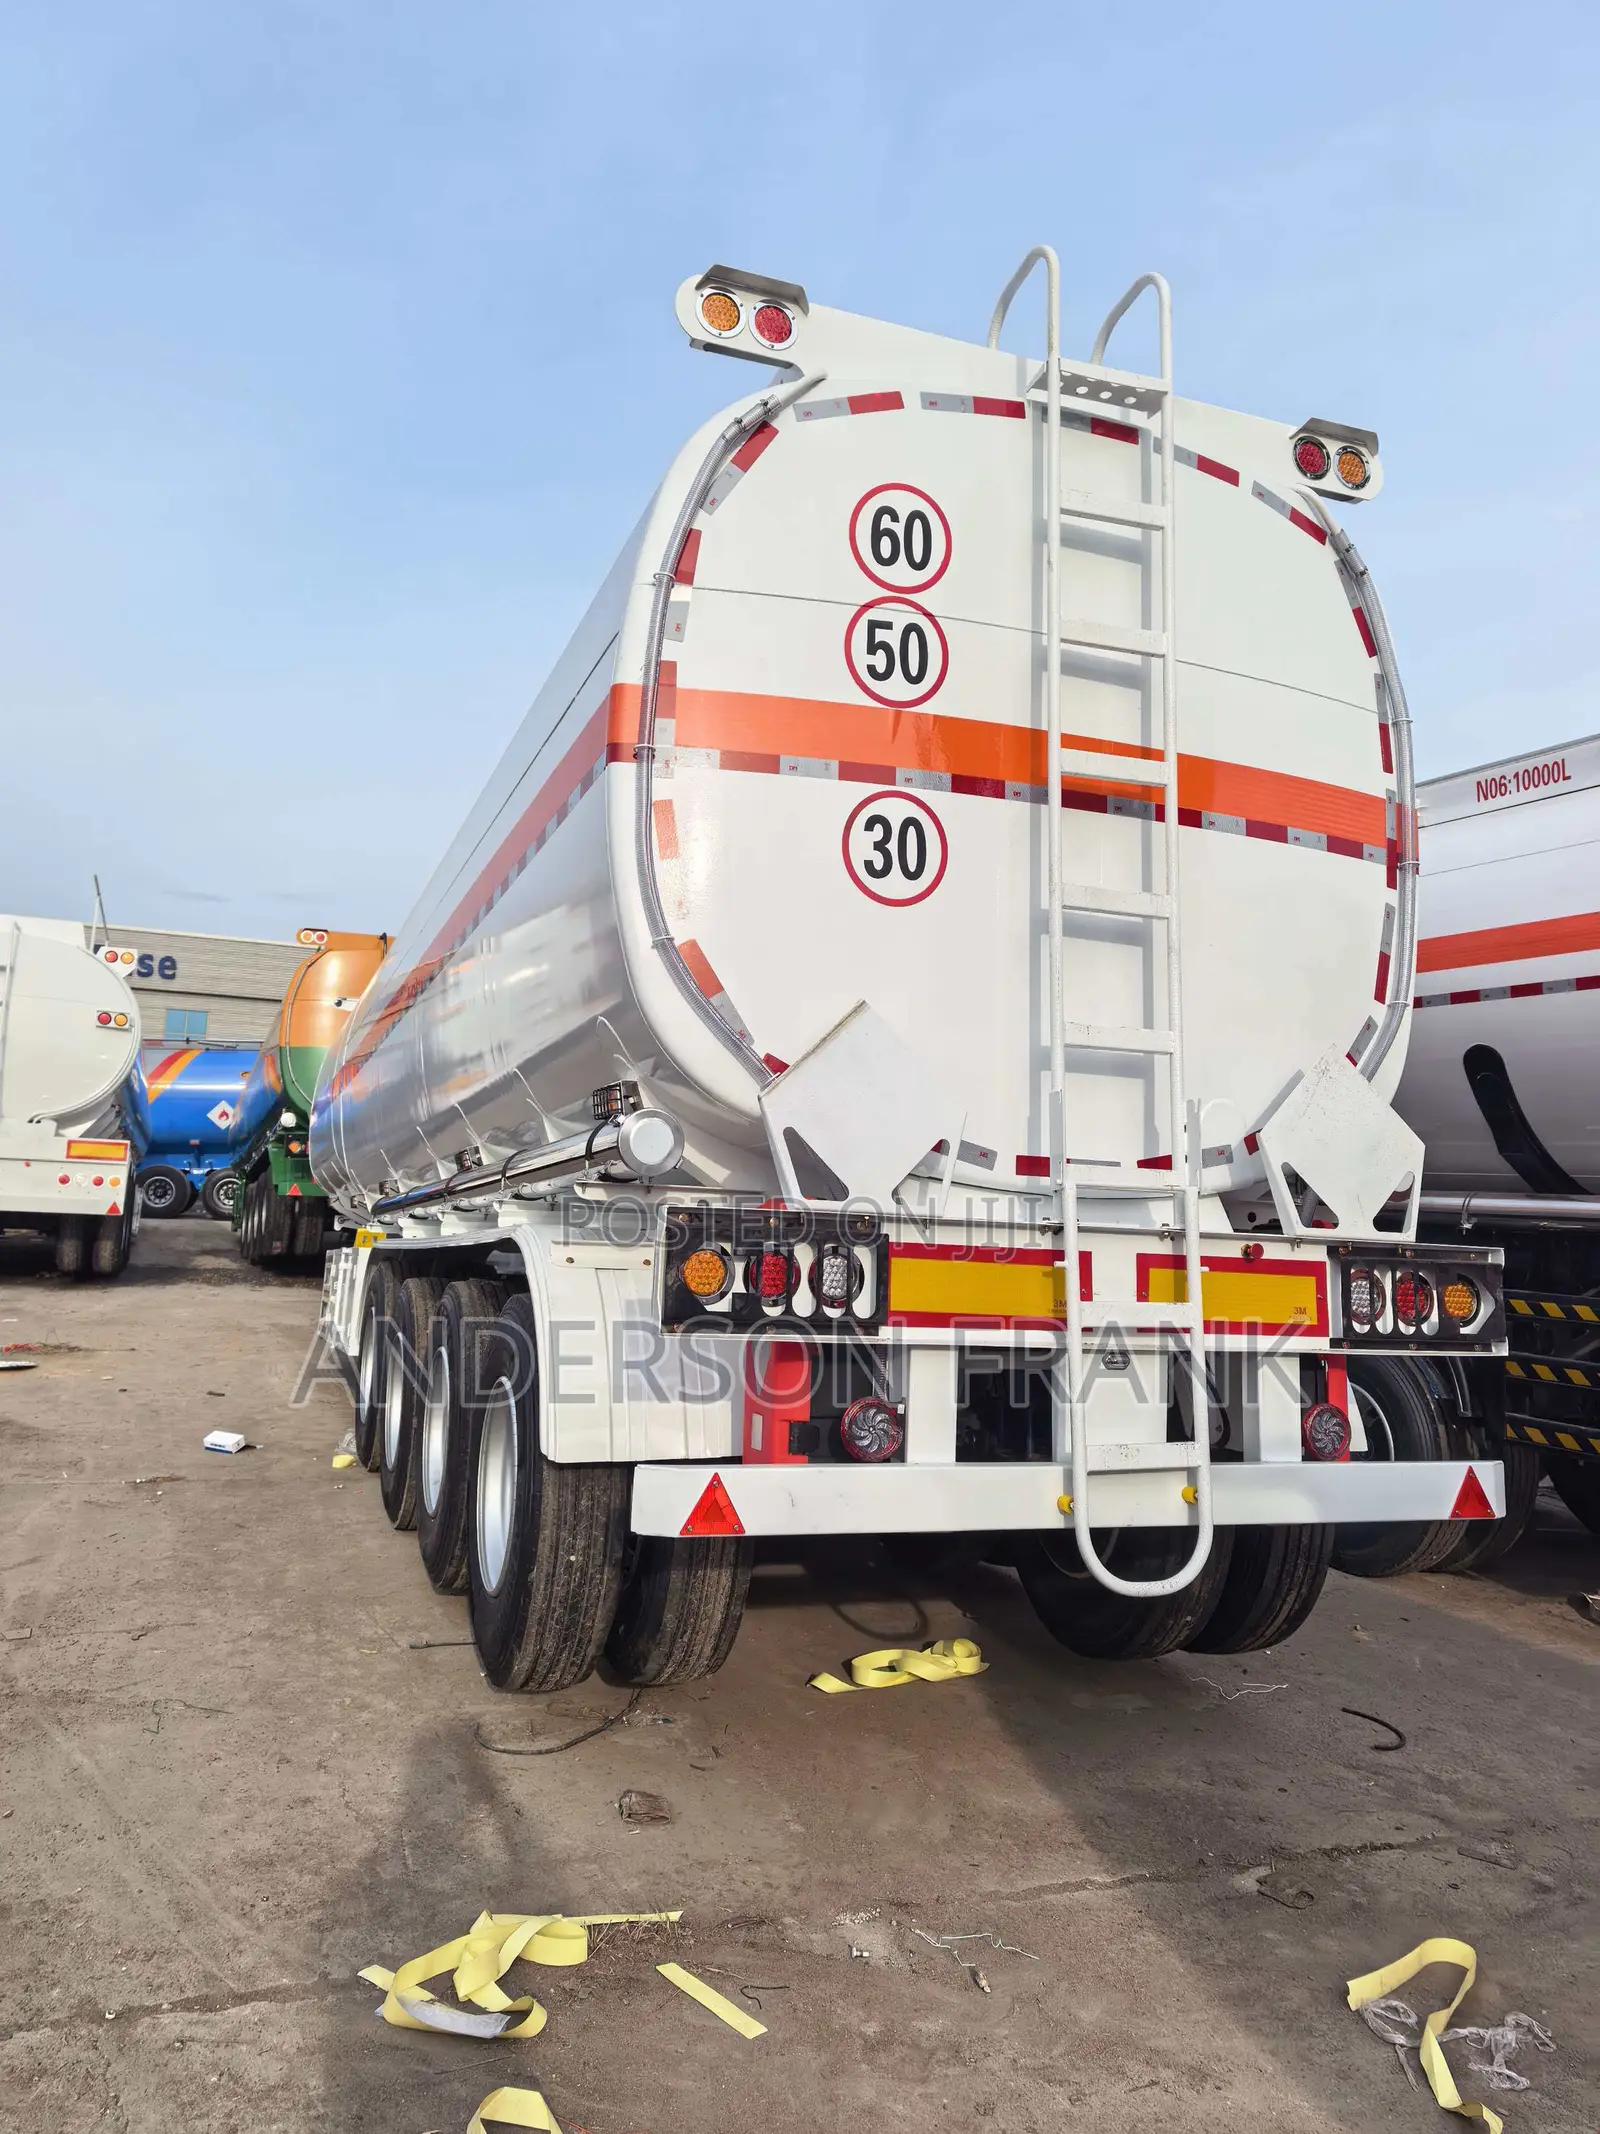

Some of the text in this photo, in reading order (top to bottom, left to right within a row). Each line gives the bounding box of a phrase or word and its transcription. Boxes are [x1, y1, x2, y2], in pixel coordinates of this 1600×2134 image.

[870, 505, 932, 571] 60
[866, 619, 928, 685] 50
[1476, 758, 1572, 803] N06:10000L
[864, 814, 926, 881] 30
[1293, 1306, 1307, 1315] 3M
